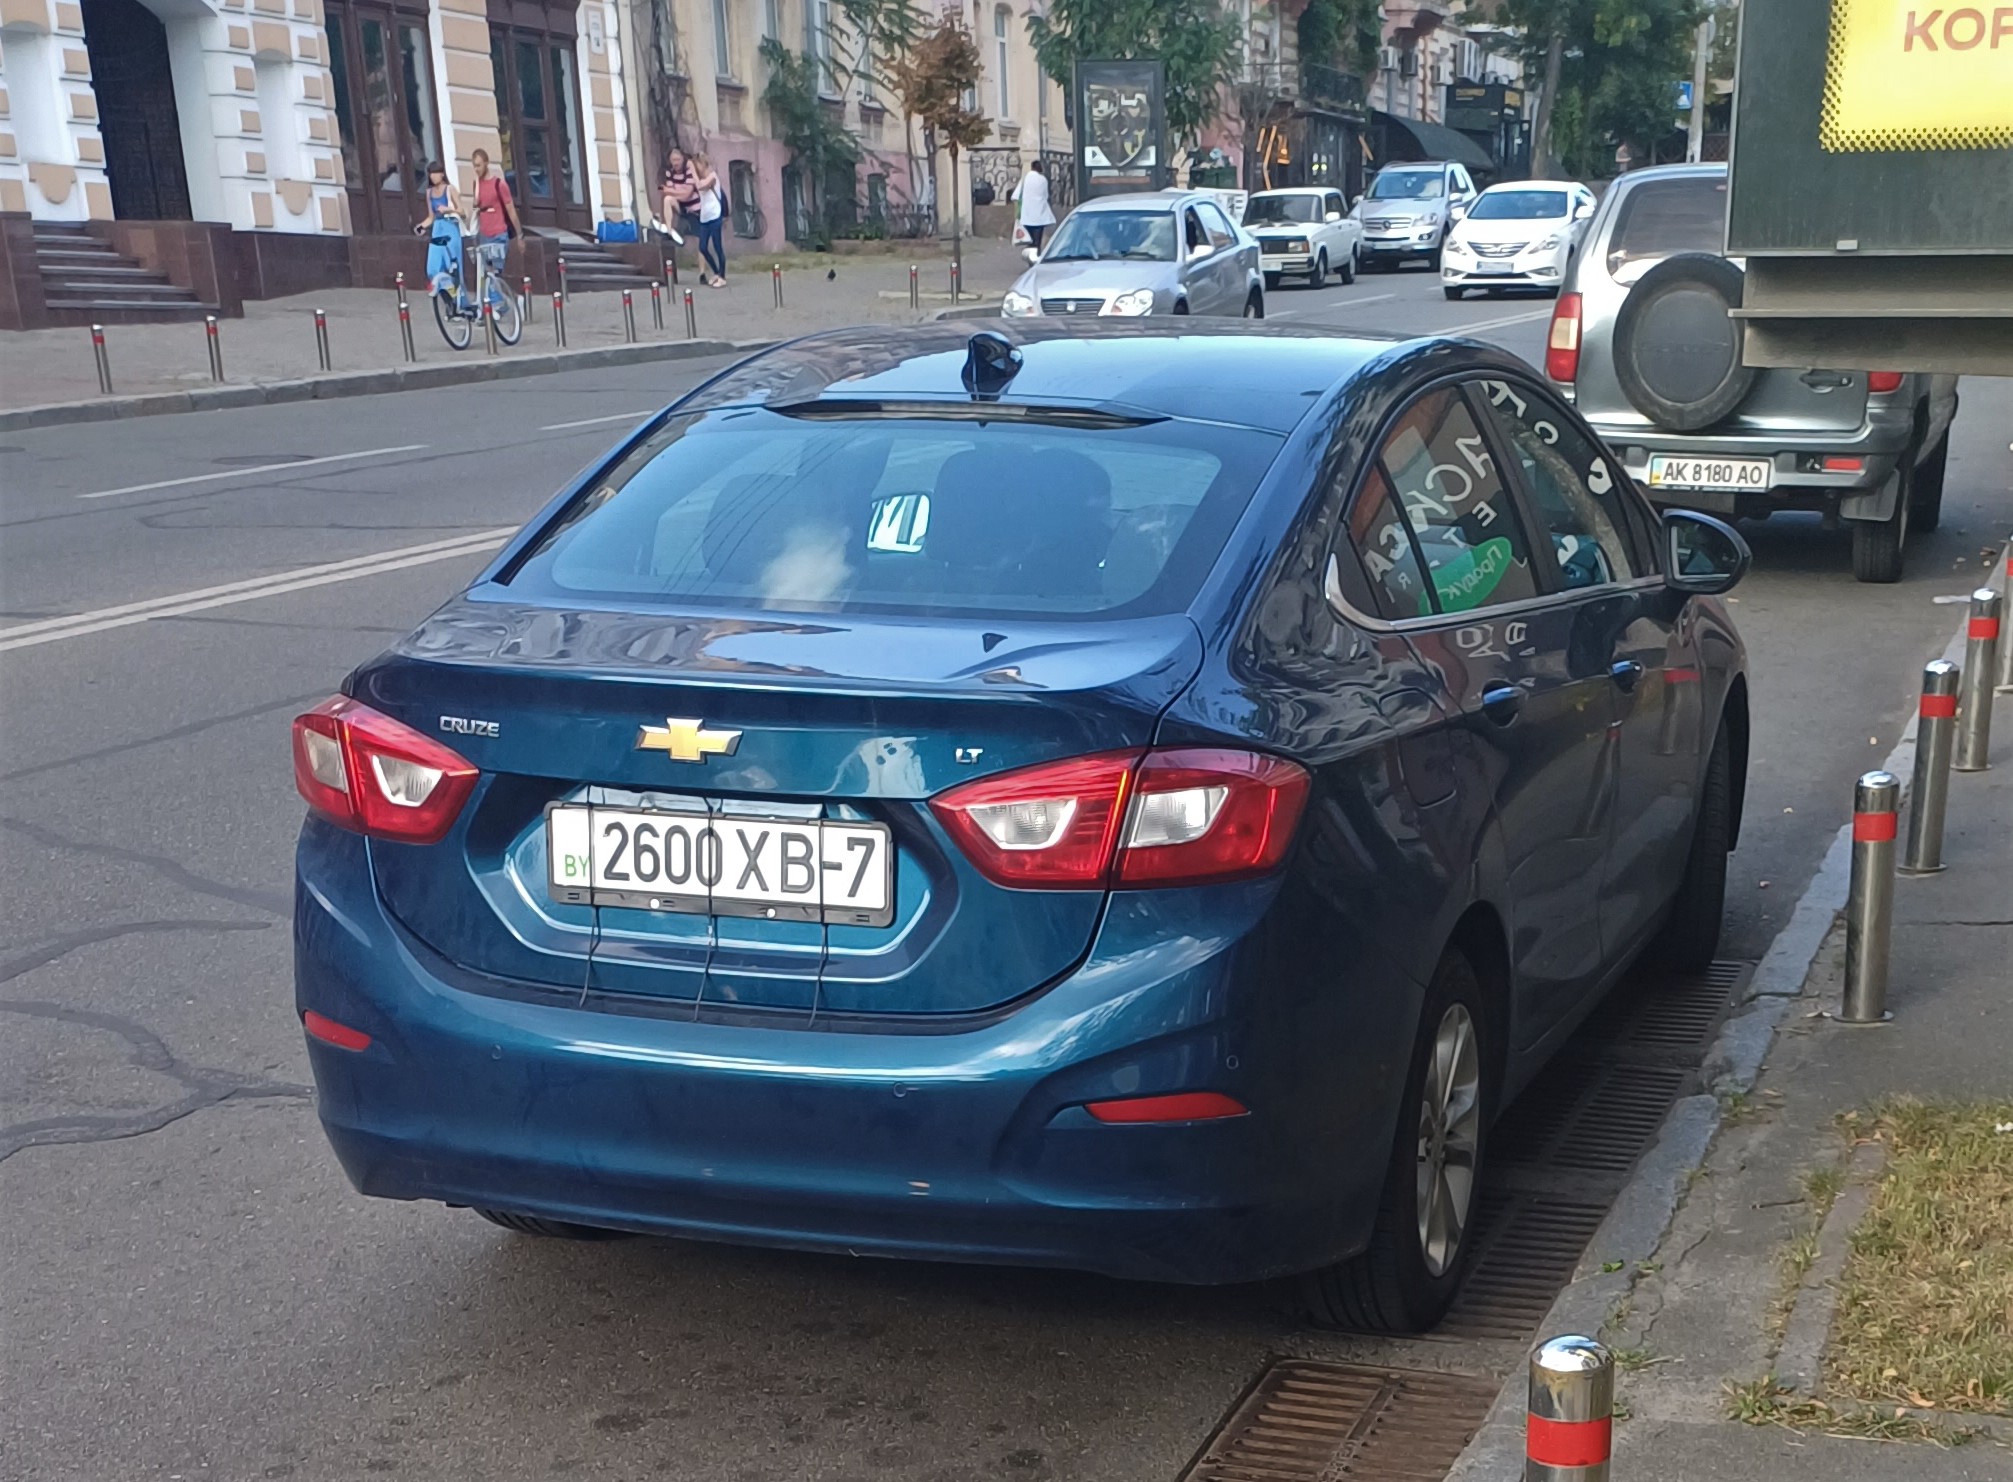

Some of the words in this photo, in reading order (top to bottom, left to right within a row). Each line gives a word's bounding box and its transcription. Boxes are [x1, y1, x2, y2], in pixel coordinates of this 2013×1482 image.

[1662, 461, 1689, 482] AK
[1692, 463, 1733, 483] 8180
[1735, 465, 1763, 485] AO
[439, 715, 500, 738] CRUZE
[955, 748, 984, 764] LT
[564, 854, 591, 878] BY
[602, 821, 723, 887] 2600
